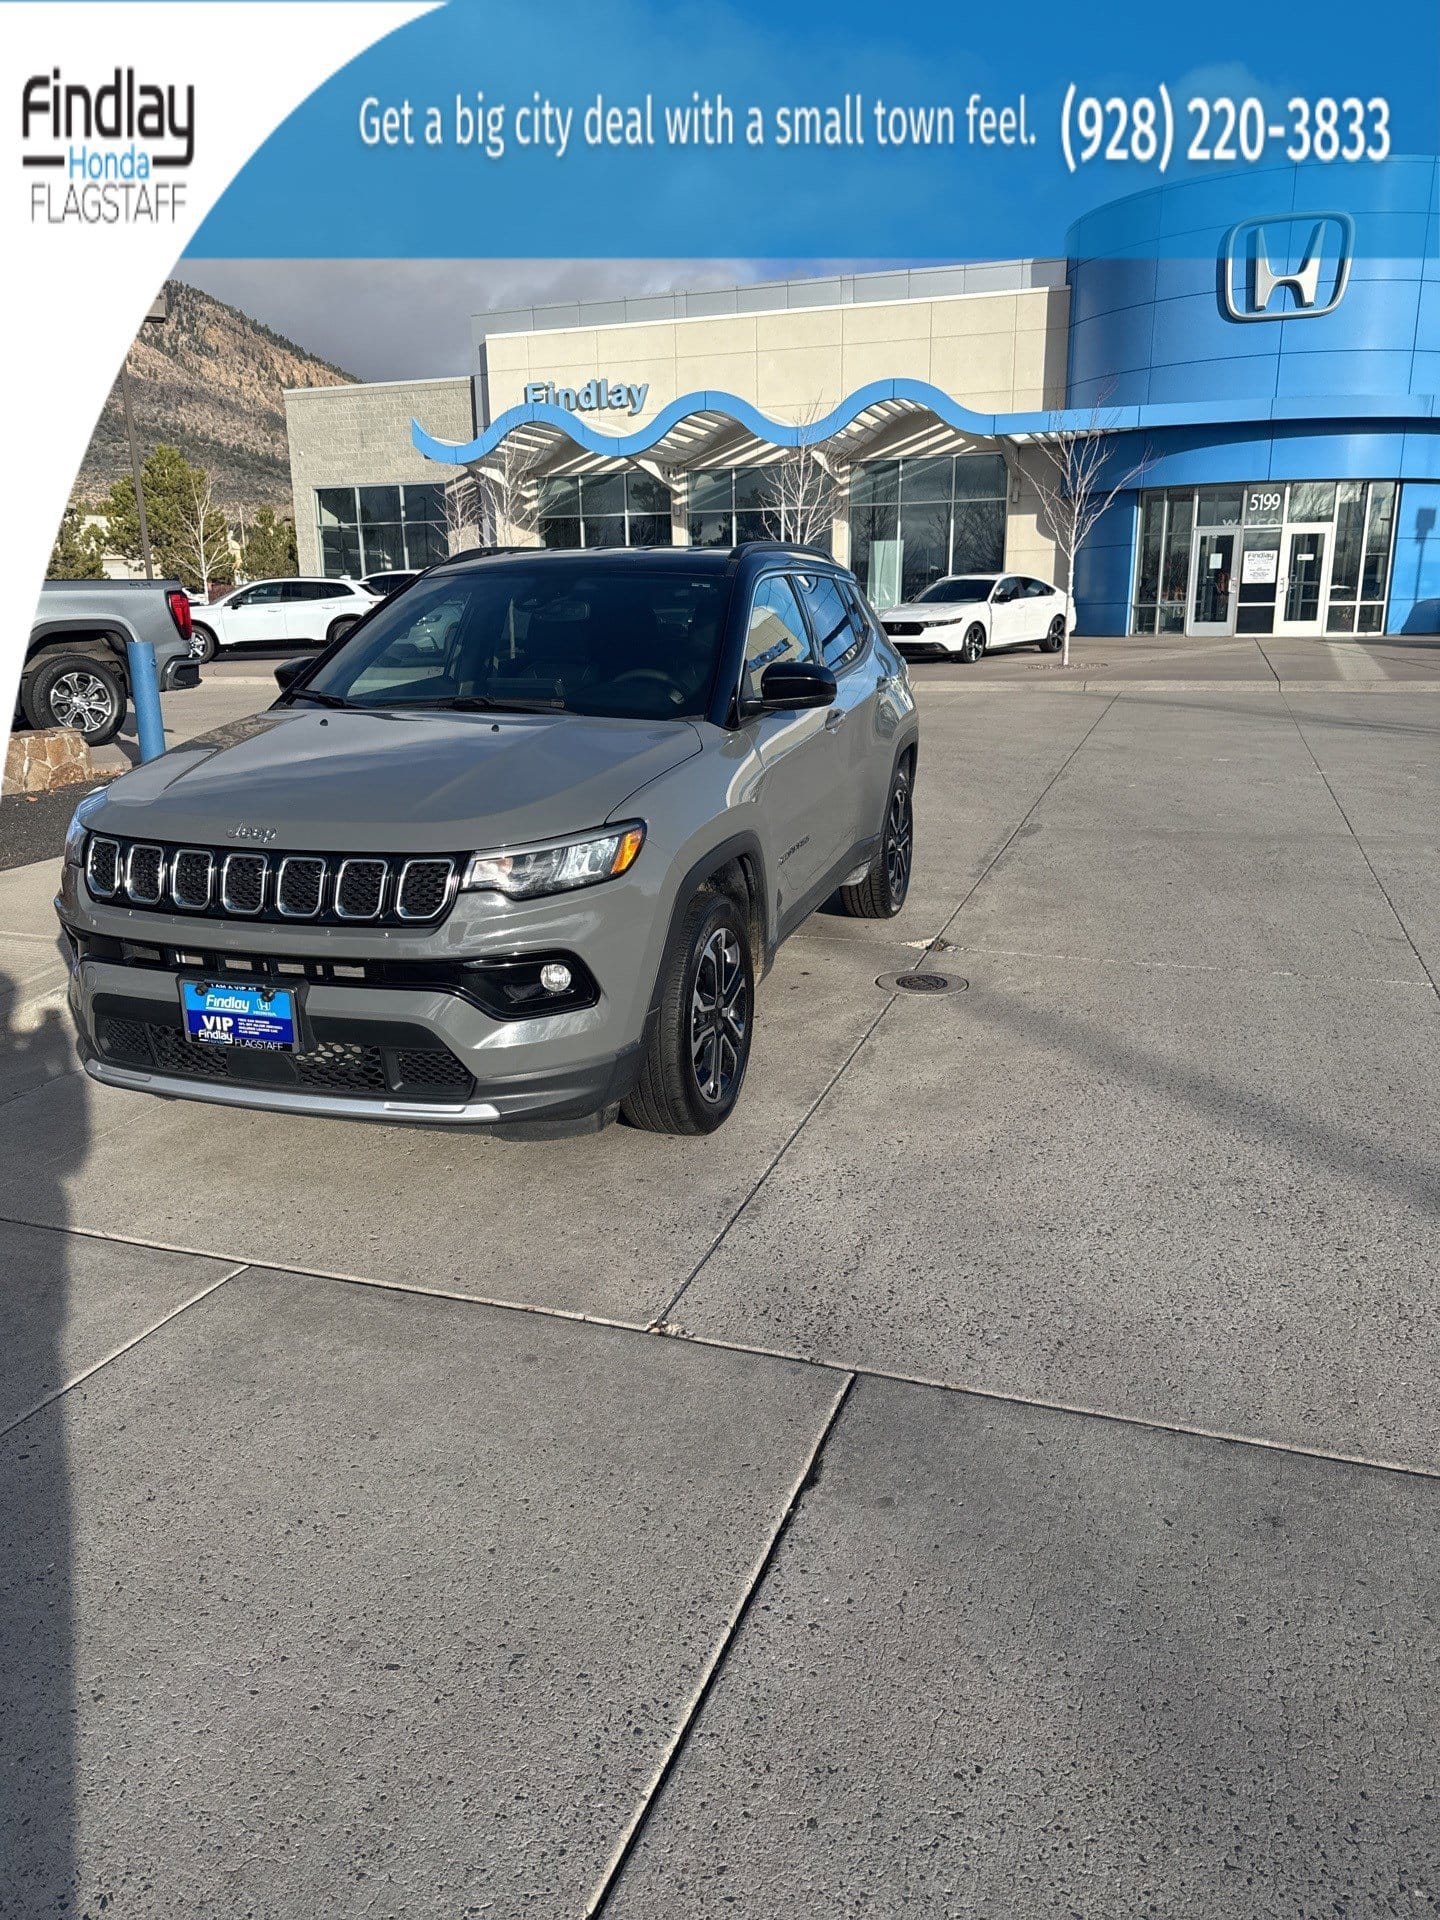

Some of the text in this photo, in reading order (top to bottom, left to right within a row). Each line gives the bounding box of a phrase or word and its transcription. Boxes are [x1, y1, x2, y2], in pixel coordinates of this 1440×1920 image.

[524, 378, 649, 416] Findlay
[1249, 493, 1281, 511] 5199
[226, 821, 277, 843] Jeep
[206, 994, 250, 1013] Findlay
[202, 1015, 234, 1031] VIP
[198, 1029, 234, 1044] Findlay
[235, 1038, 284, 1050] FLAGSTAFF
